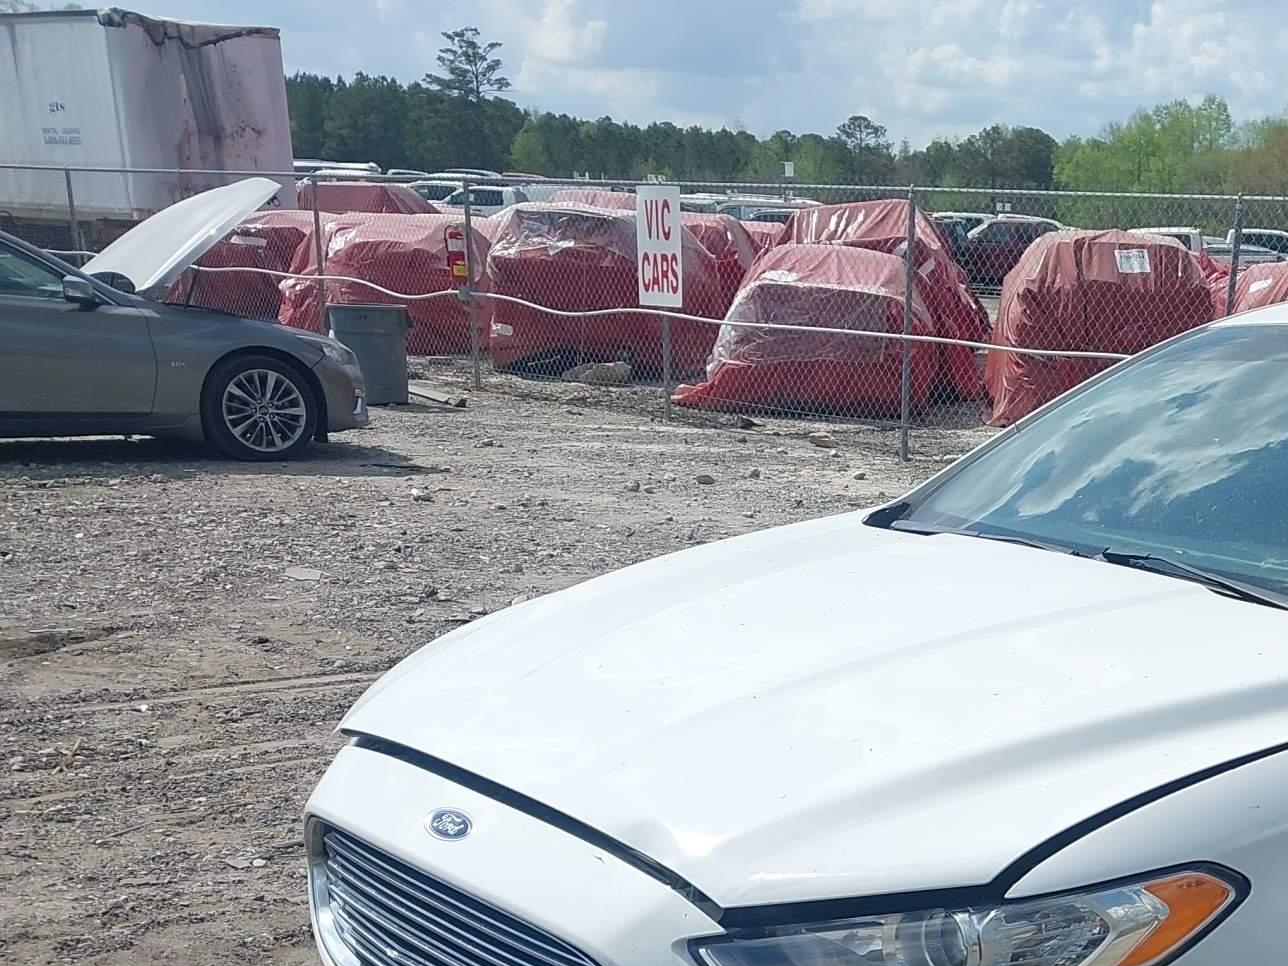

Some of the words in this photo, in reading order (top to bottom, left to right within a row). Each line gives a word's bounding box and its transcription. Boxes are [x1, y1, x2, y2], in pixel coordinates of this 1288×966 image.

[644, 198, 671, 241] VIC
[641, 251, 679, 295] CARS
[432, 813, 465, 835] Ford
